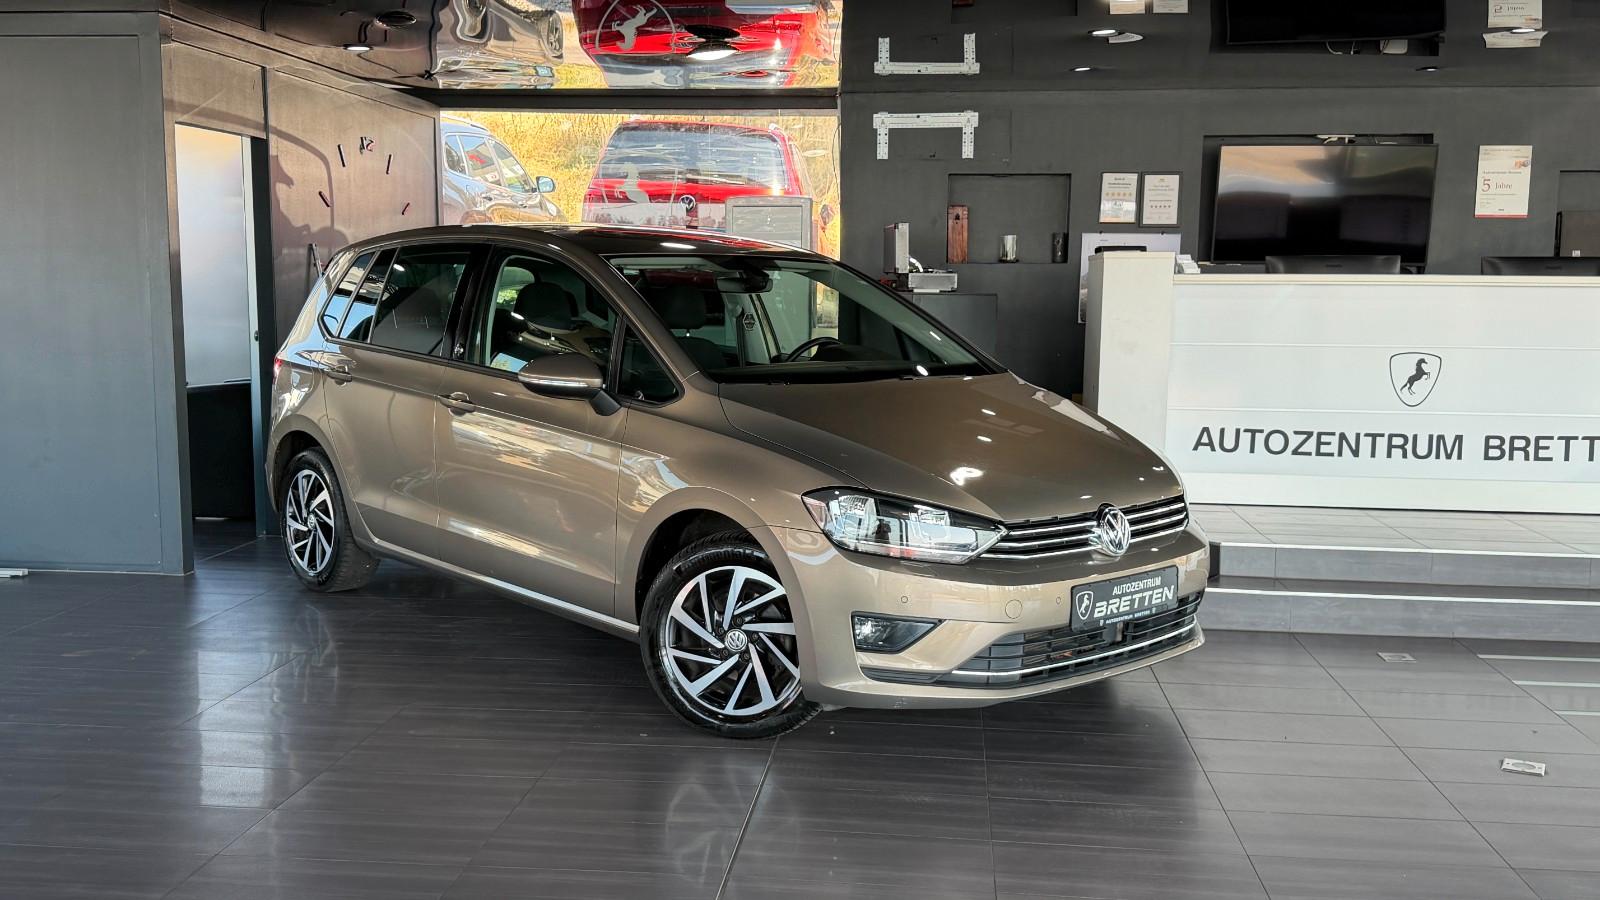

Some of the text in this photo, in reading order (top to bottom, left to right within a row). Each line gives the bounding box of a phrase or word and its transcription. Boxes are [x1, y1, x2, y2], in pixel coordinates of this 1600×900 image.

[1481, 178, 1513, 192] 5 Jahre
[1192, 426, 1600, 462] AUTOZENTRUM BRETT
[1112, 576, 1161, 596] AUTOZENTRUM
[1093, 585, 1175, 618] BRETTEN
